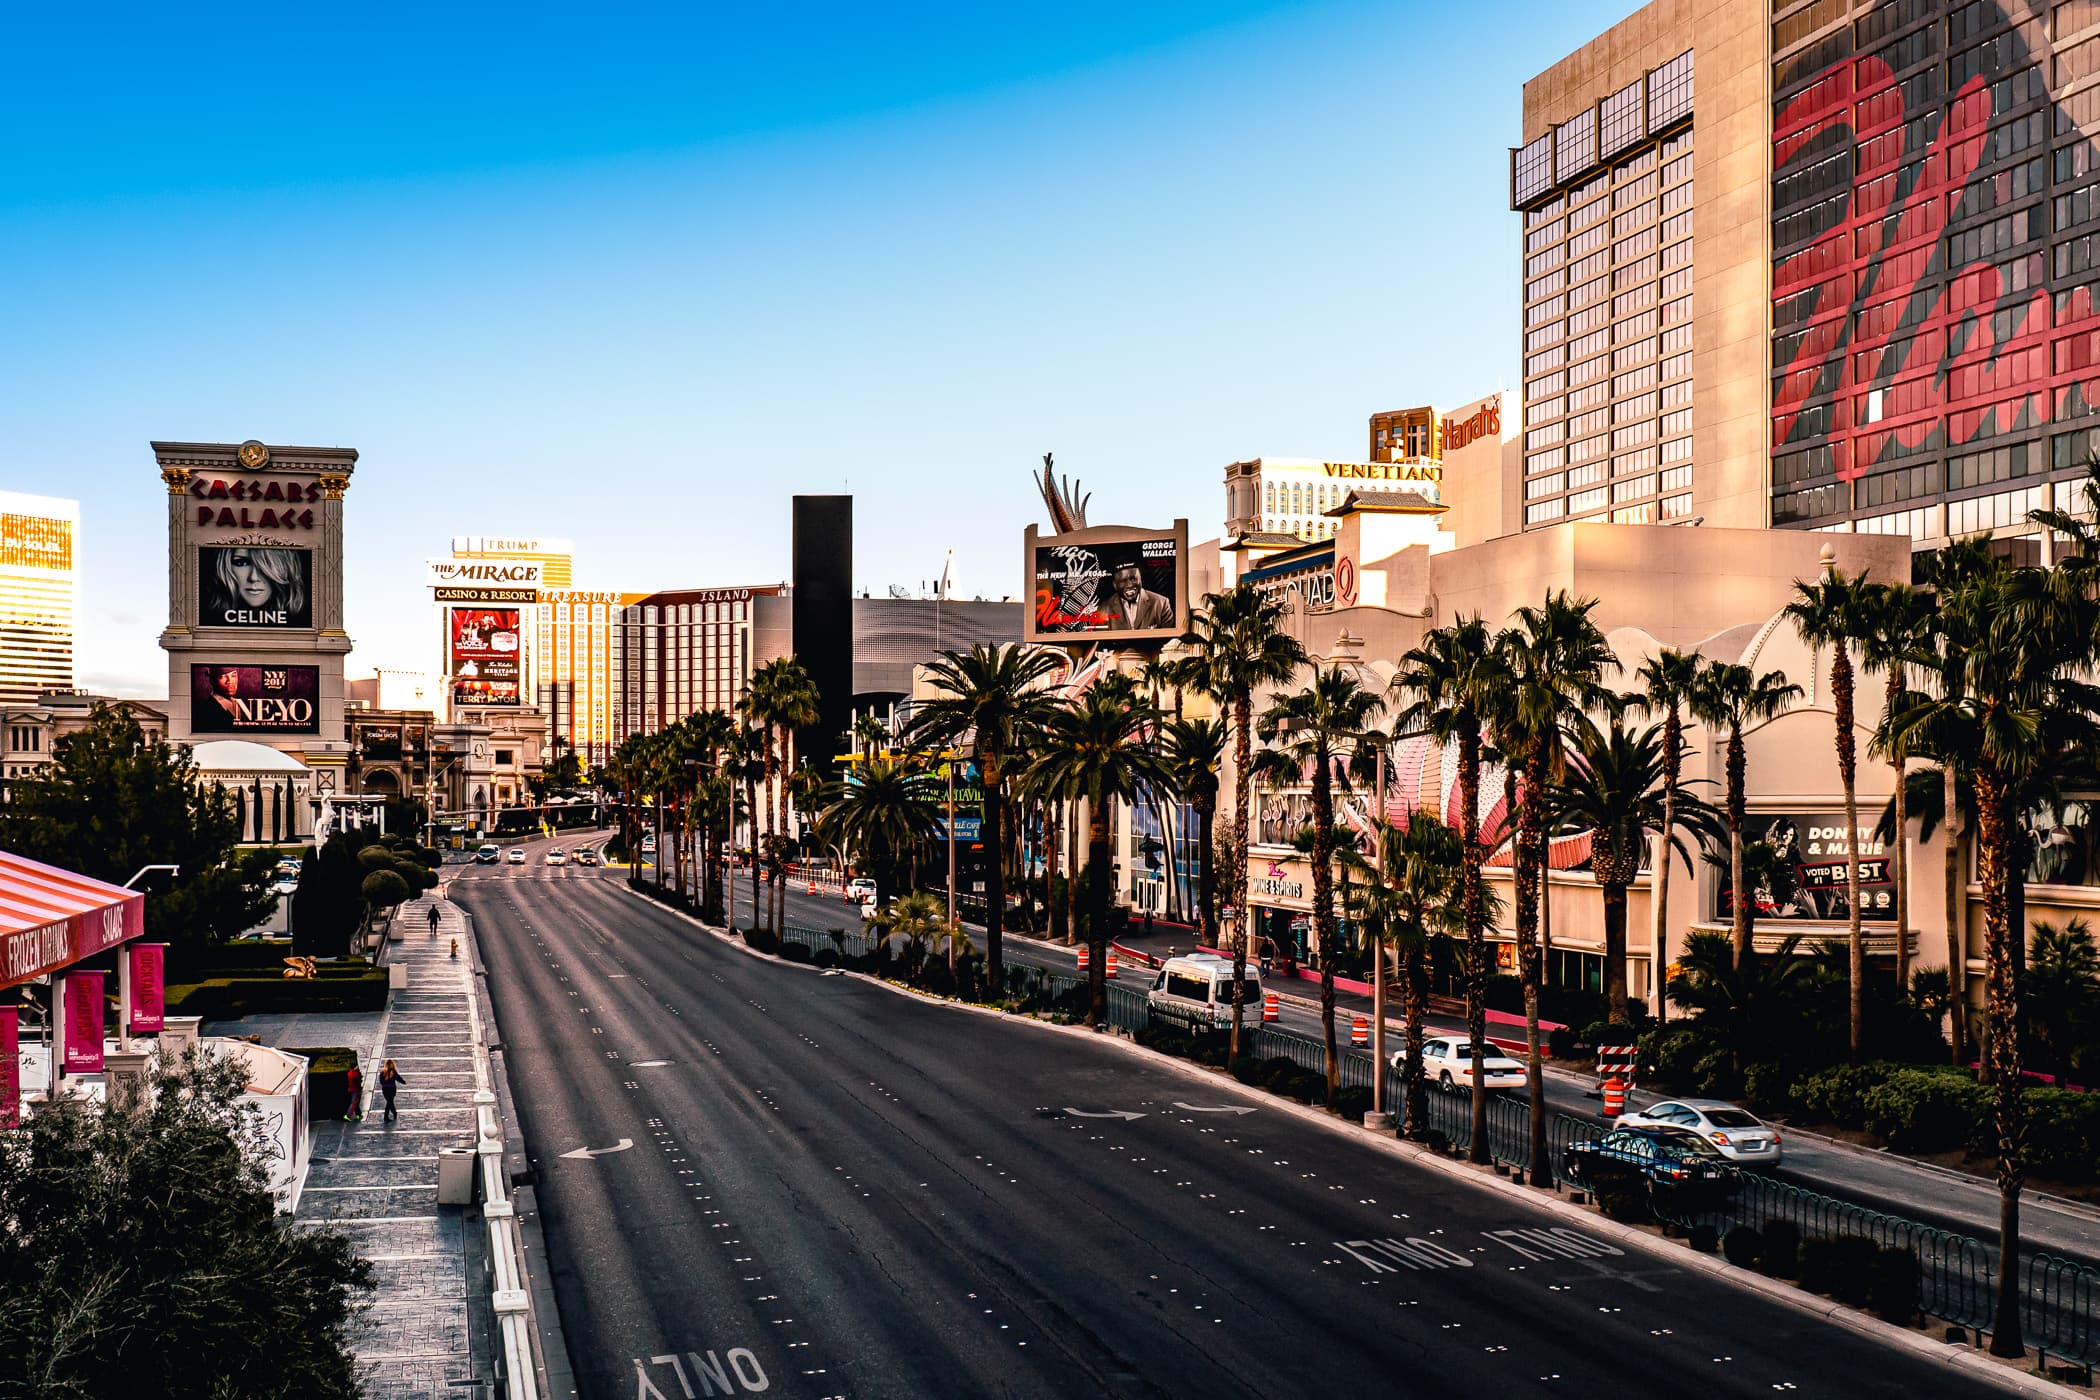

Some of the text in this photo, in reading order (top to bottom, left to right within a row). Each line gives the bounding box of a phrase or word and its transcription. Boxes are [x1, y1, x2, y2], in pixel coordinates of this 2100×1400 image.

[190, 478, 320, 502] CAESARS
[198, 505, 313, 529] PALACE
[488, 539, 539, 551] TRUMP
[1142, 542, 1174, 550] GEORGE
[1142, 549, 1177, 558] WALLACE
[432, 564, 538, 582] THE MIRAGE
[436, 590, 535, 601] CASINO & RESORT
[539, 590, 623, 604] TREASURE
[700, 588, 750, 602] ISLAND
[224, 609, 288, 624] CELINE
[264, 671, 286, 679] NYE
[456, 695, 486, 704] TERRY
[233, 697, 313, 722] NE-YO
[1807, 842, 1822, 855] &
[1805, 867, 1831, 877] VOTED
[1252, 878, 1270, 895] WINE
[1276, 881, 1303, 898] SPIRITS
[102, 903, 125, 945] SALADS
[8, 920, 69, 980] FROZEN DRINKS
[140, 951, 154, 1007] COCKTAILS
[1480, 1227, 1625, 1262] ONLY
[1332, 1237, 1474, 1273] ONLY
[633, 1347, 770, 1400] ONLY
